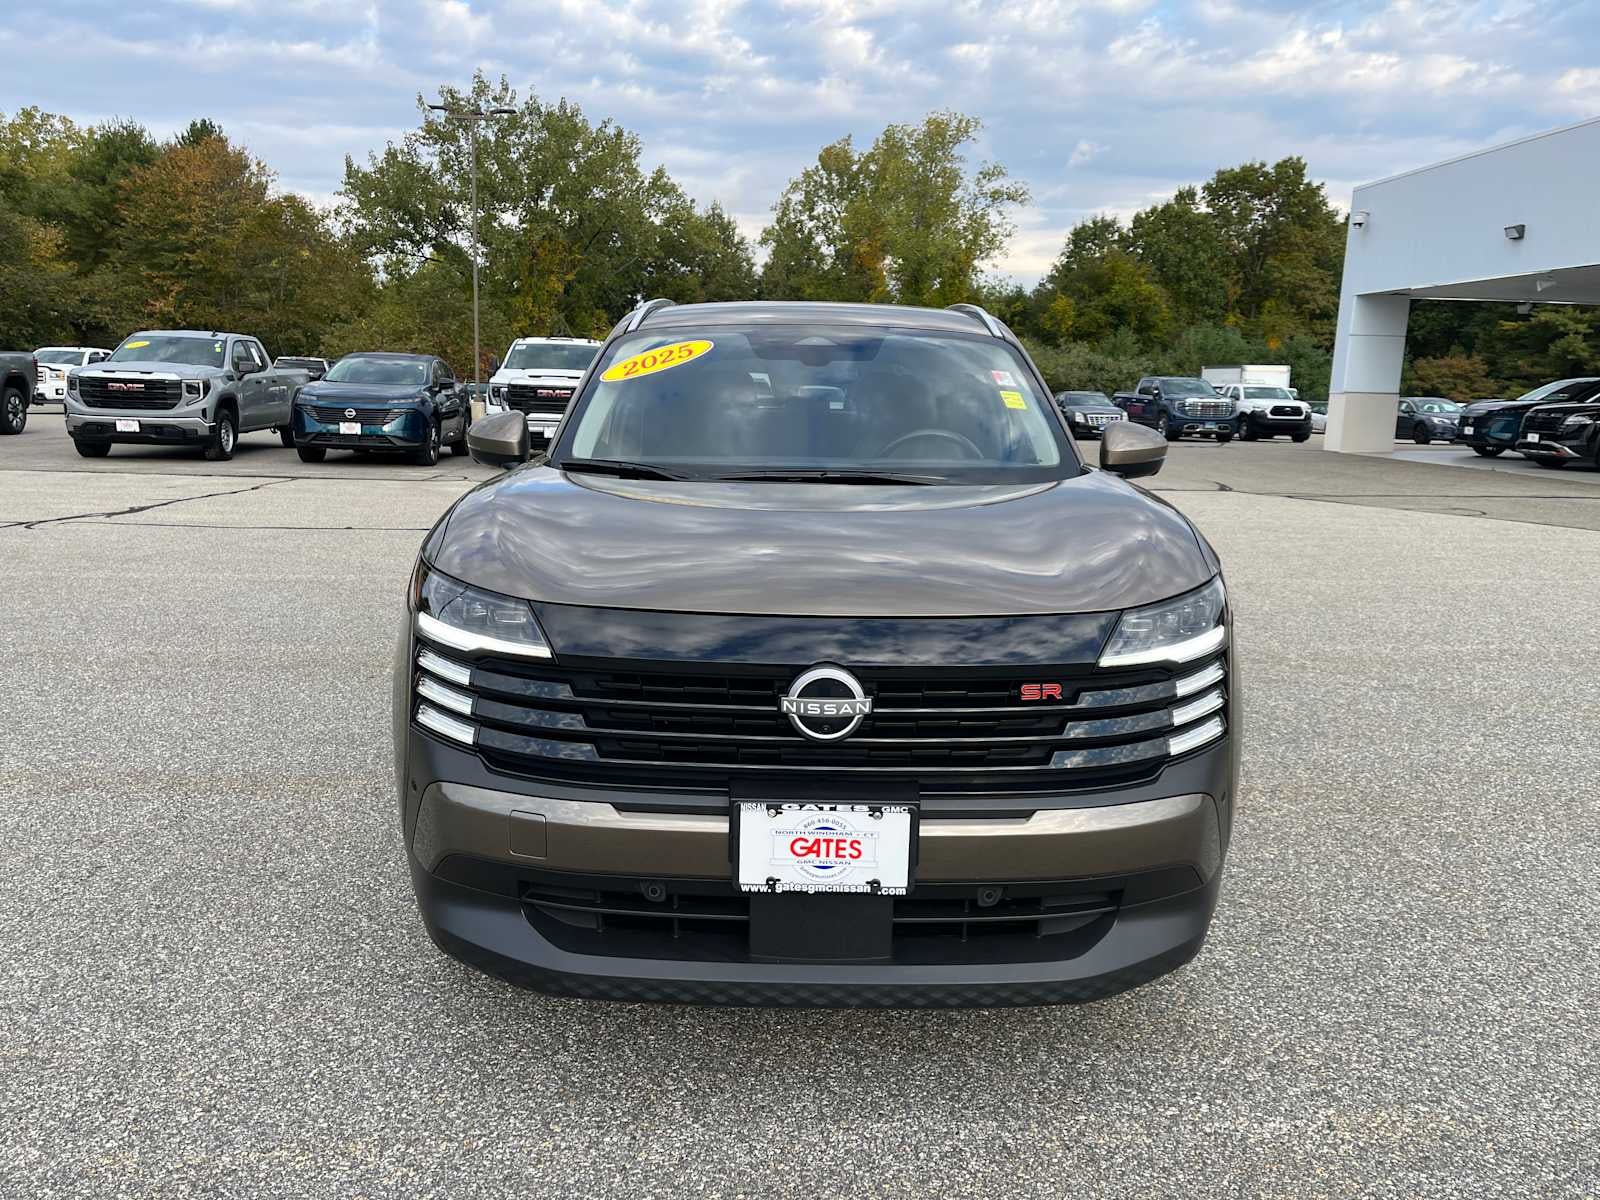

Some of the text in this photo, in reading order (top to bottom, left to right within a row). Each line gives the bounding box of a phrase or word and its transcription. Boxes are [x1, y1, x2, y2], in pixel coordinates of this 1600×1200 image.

[623, 344, 695, 376] 2025
[1020, 683, 1062, 700] SR
[782, 699, 871, 715] NISSAN
[740, 803, 908, 814] NISSAN GATES GMC
[790, 837, 862, 859] GATES
[741, 885, 772, 893] www.
[775, 882, 871, 894] gatesgmcnissan
